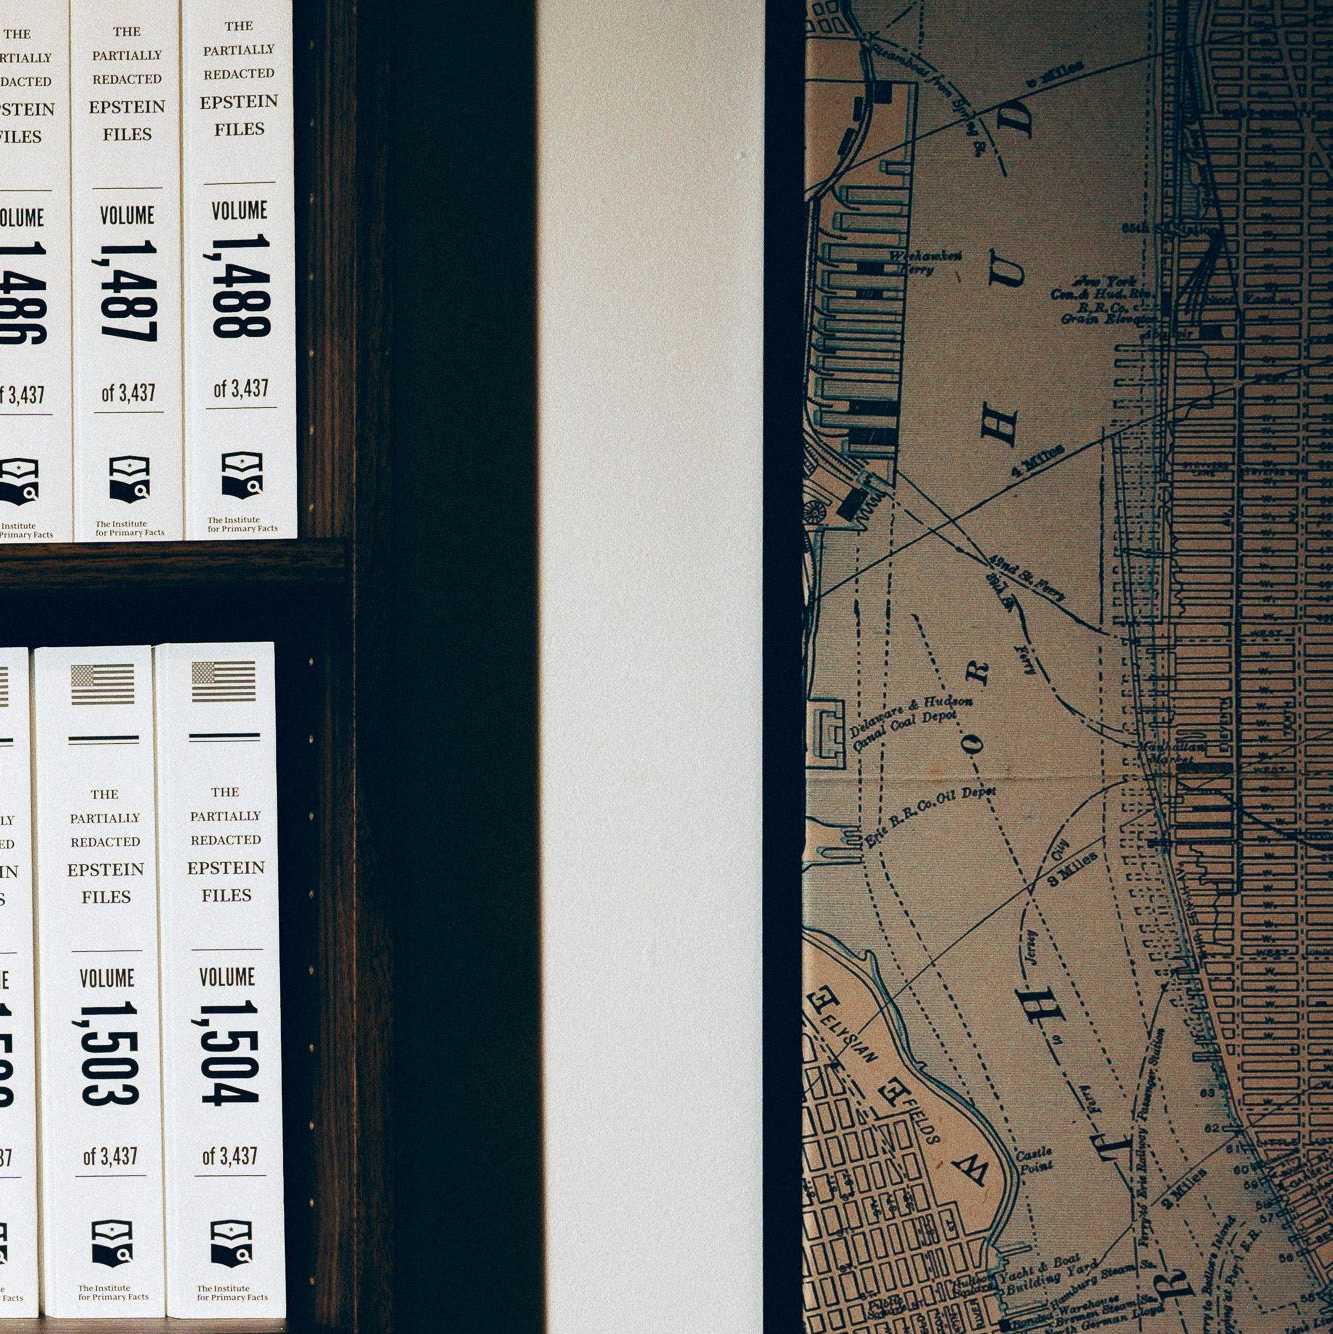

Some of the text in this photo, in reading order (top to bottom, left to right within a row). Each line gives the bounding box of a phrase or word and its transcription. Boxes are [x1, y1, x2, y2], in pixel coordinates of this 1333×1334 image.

[202, 233, 272, 339] 1,488
[1010, 443, 1066, 479] 4 Miles
[849, 695, 973, 740] Delaware & Hudson
[853, 709, 958, 752] Canal Coal Depot
[962, 785, 997, 800] Depot
[1059, 850, 1099, 880] Miles
[190, 999, 260, 1107] 1,504
[820, 1012, 941, 1146] ELYSIAN FIELDS
[1015, 1145, 1053, 1162] Castle
[1020, 1159, 1054, 1176] Point
[1170, 1168, 1207, 1202] Miles
[997, 1266, 1035, 1284] Yacht
[1053, 1252, 1081, 1268] Boat
[1006, 1272, 1061, 1296] Building
[1066, 1258, 1098, 1278] Yard
[1082, 1313, 1129, 1332] German
[1131, 1303, 1166, 1320] Lloyd
